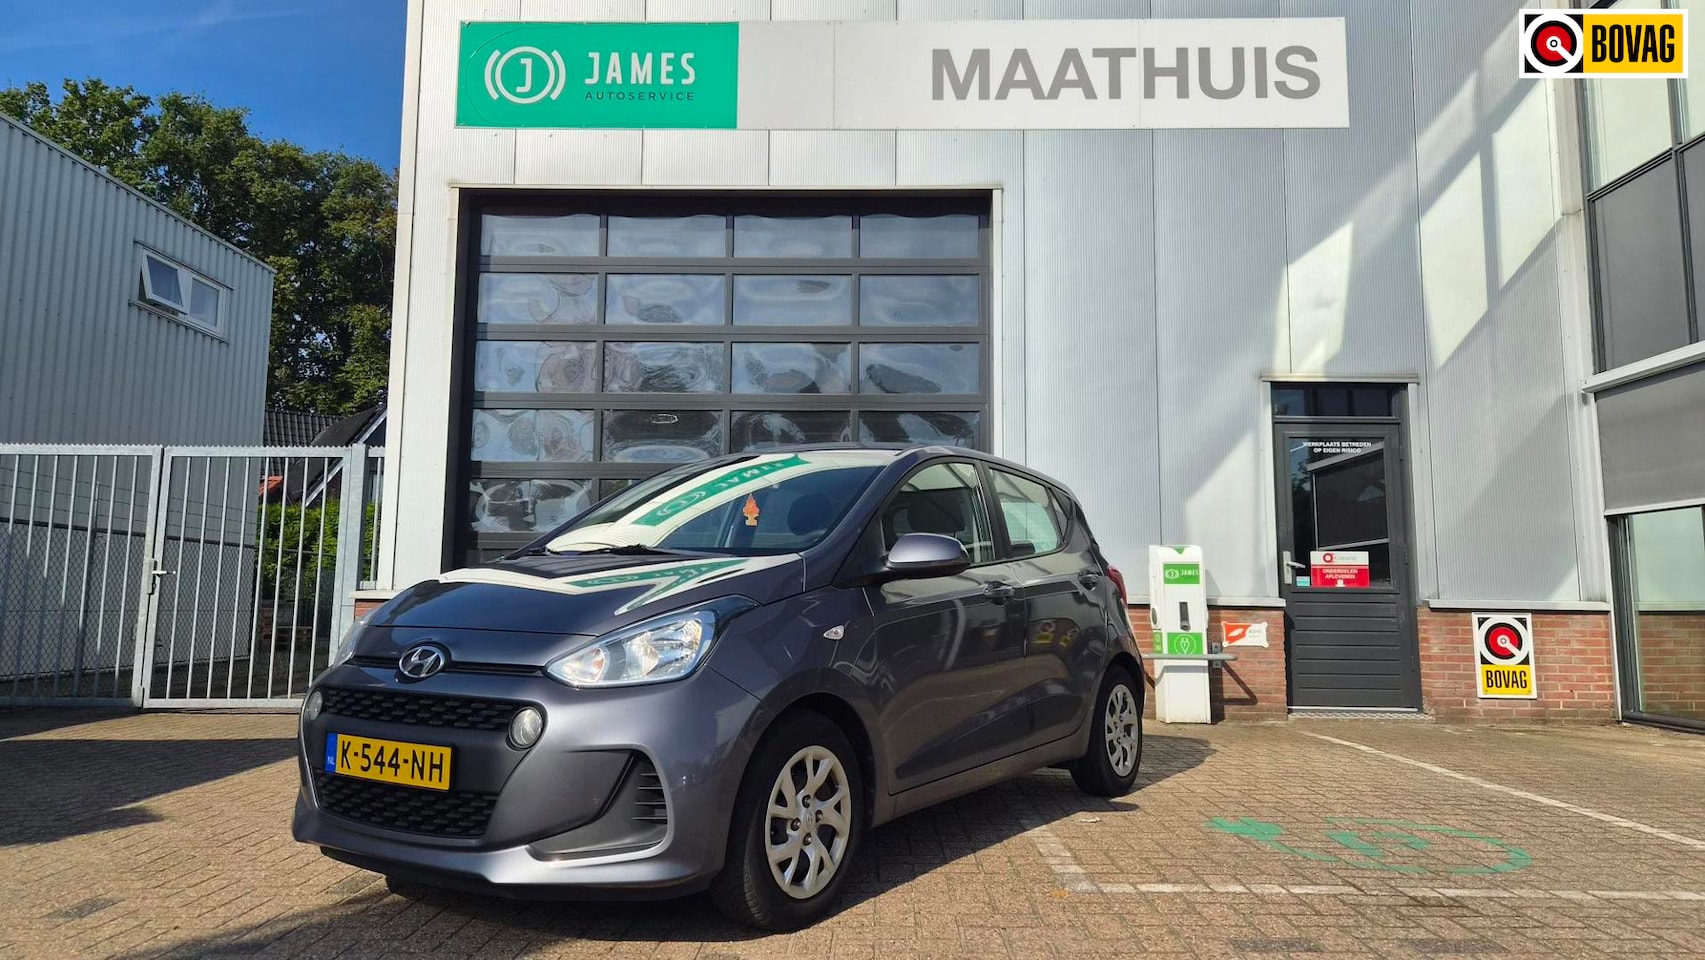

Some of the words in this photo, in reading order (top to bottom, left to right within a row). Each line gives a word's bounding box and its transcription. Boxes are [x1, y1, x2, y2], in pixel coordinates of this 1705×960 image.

[584, 51, 696, 86] JAMES
[931, 45, 1321, 101] MAATHUIS
[584, 90, 695, 102] AUTOSERVICE
[1486, 670, 1527, 689] BOVAG
[341, 740, 444, 783] K-544-NH
